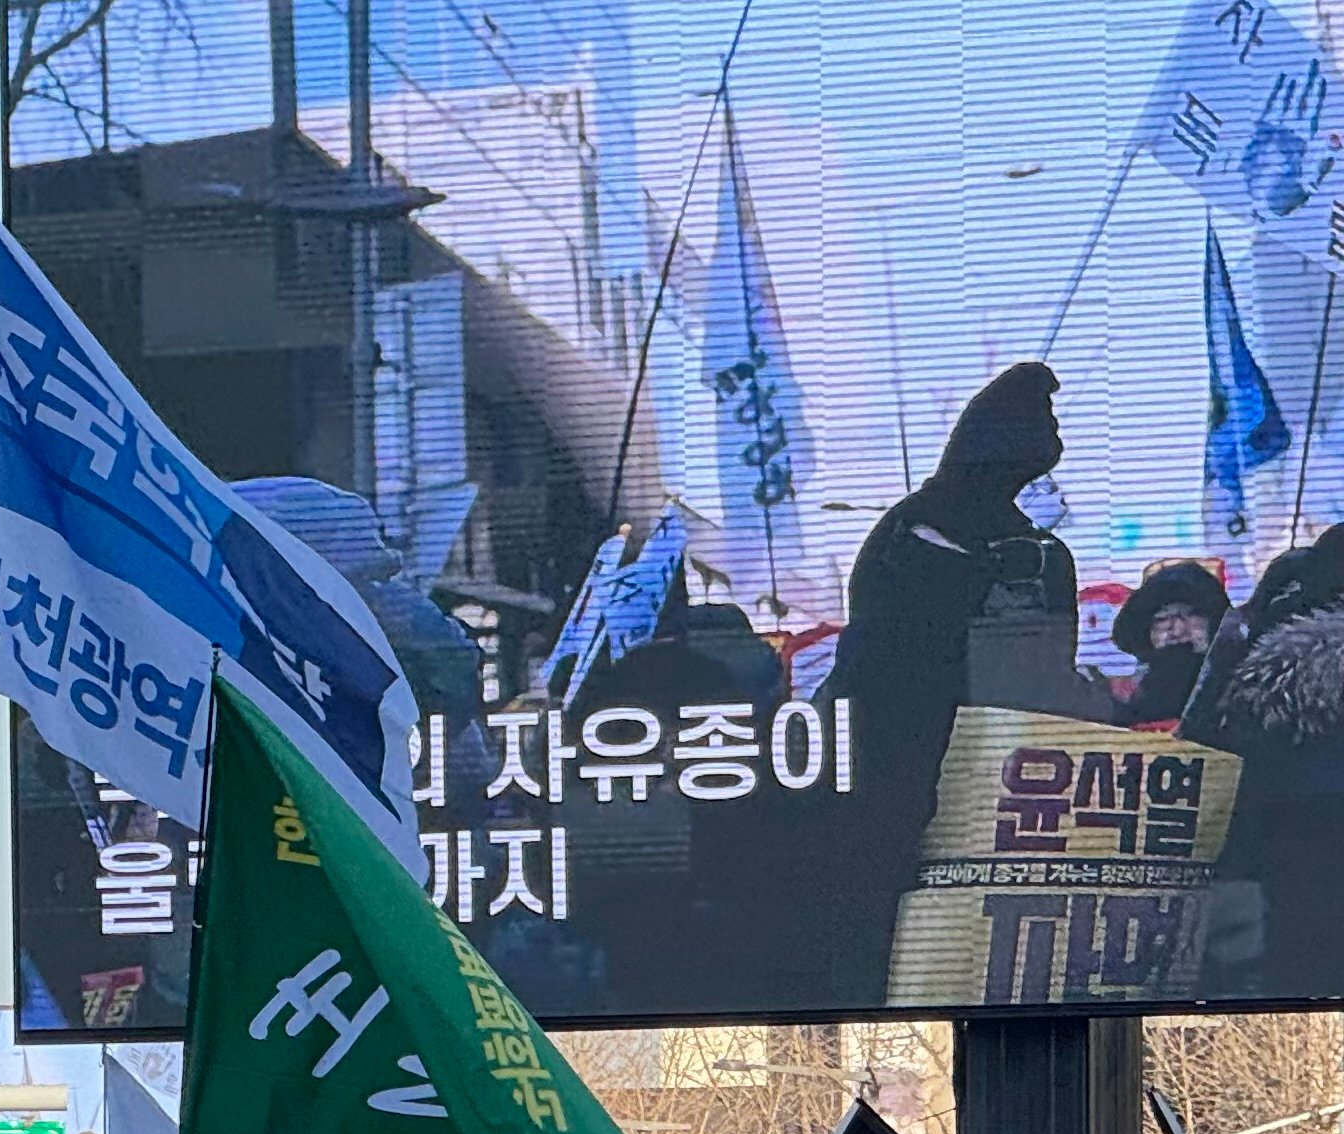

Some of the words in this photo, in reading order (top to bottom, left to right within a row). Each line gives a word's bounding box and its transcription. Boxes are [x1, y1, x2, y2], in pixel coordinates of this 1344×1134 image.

[485, 697, 854, 803] 자유종이
[994, 747, 1207, 857] 윤석열
[428, 826, 569, 923] 까지
